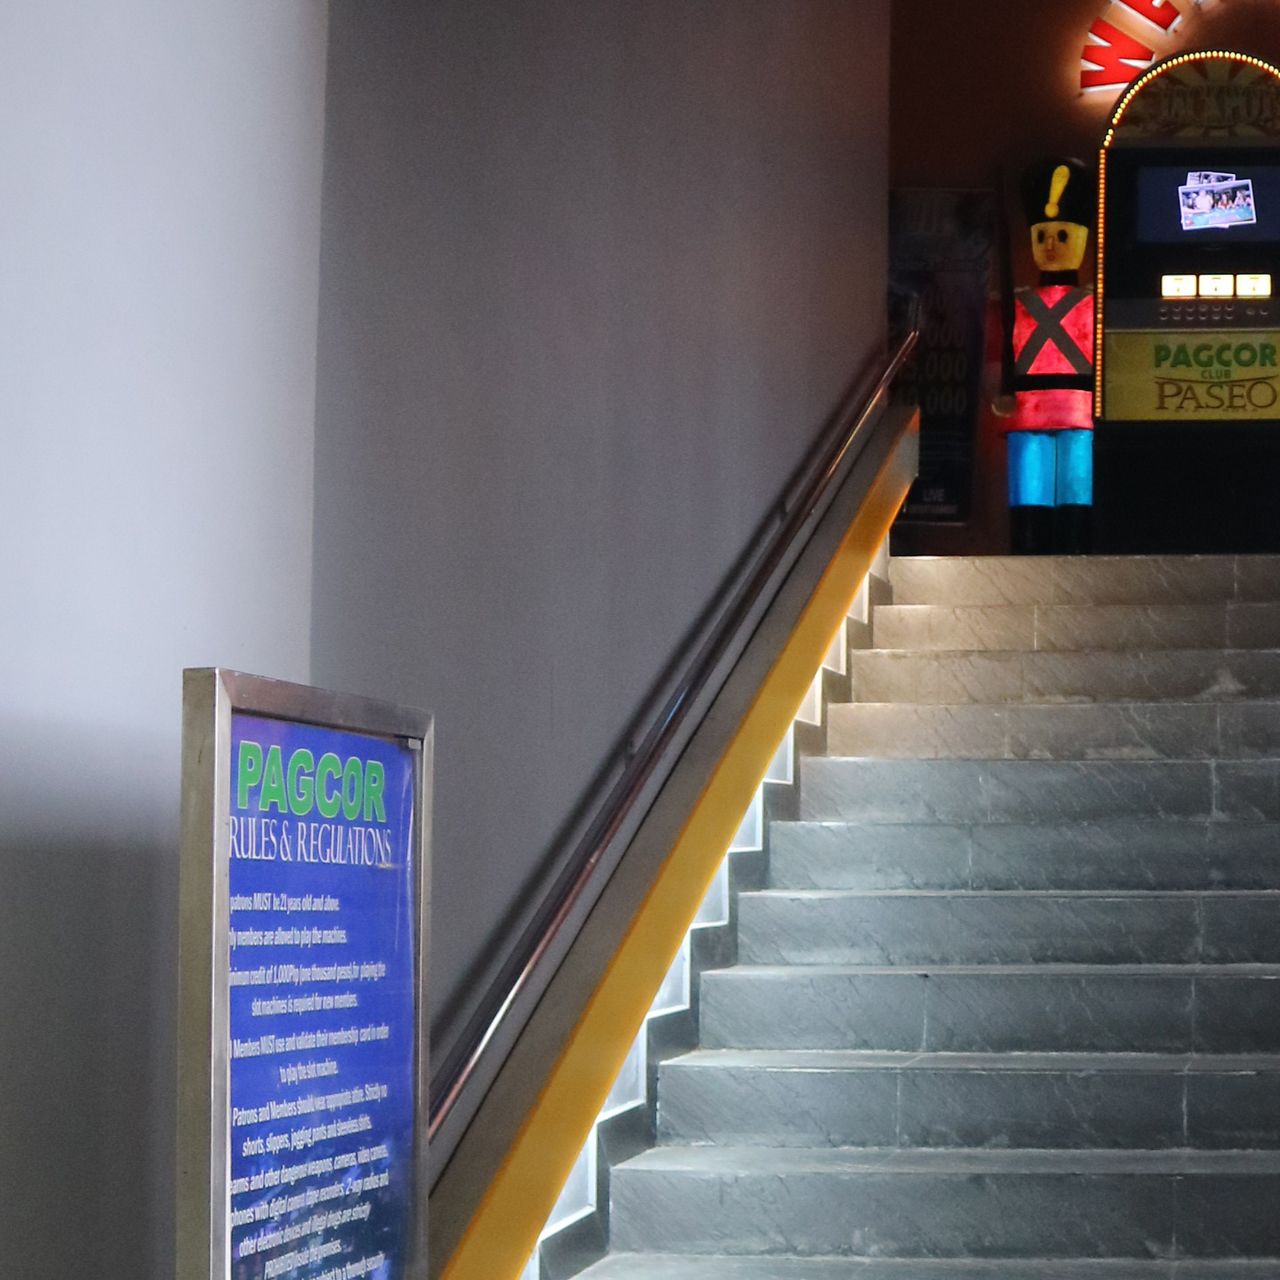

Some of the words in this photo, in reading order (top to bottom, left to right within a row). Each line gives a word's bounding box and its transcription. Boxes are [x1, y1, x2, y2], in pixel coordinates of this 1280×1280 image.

[1154, 342, 1279, 368] PAGCOR
[1201, 369, 1231, 380] CLUB
[1154, 381, 1279, 410] PASEO
[237, 740, 387, 823] PAGCOR
[230, 815, 278, 861] RULES
[280, 820, 293, 863] &
[297, 822, 392, 867] REGULATIONS
[233, 1106, 258, 1127] Patrons
